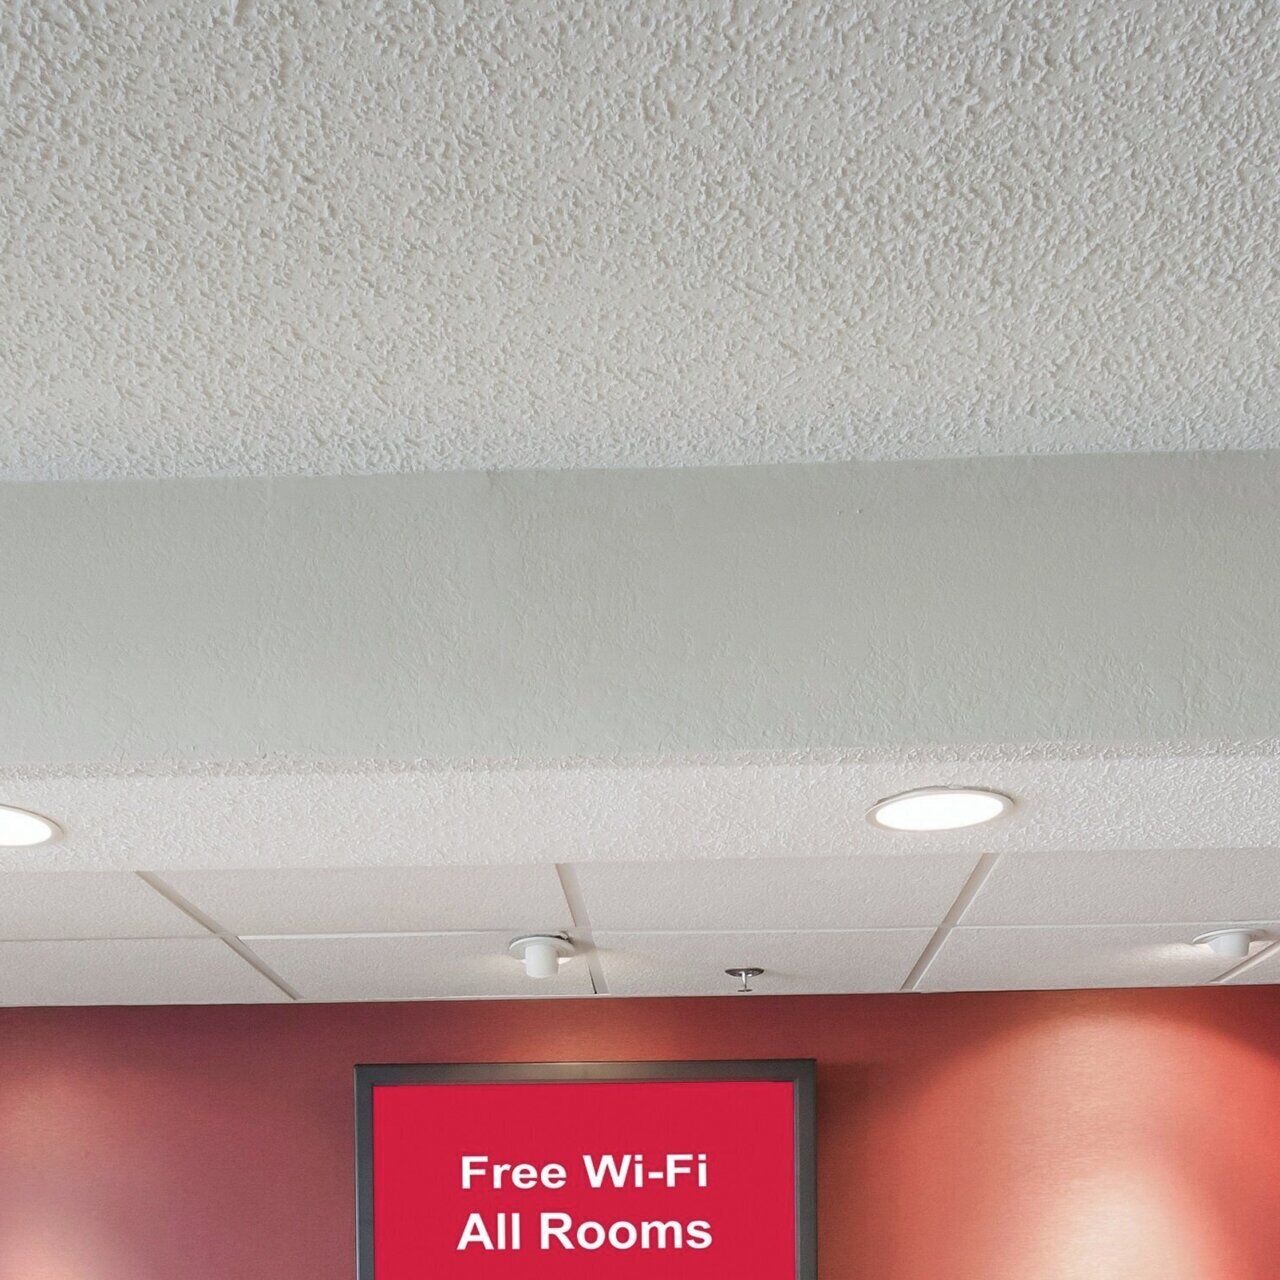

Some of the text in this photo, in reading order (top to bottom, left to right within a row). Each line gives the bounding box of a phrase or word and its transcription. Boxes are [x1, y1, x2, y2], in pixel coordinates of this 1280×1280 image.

[461, 1153, 707, 1190] Free Wi-Fi
[456, 1212, 713, 1251] All Rooms
